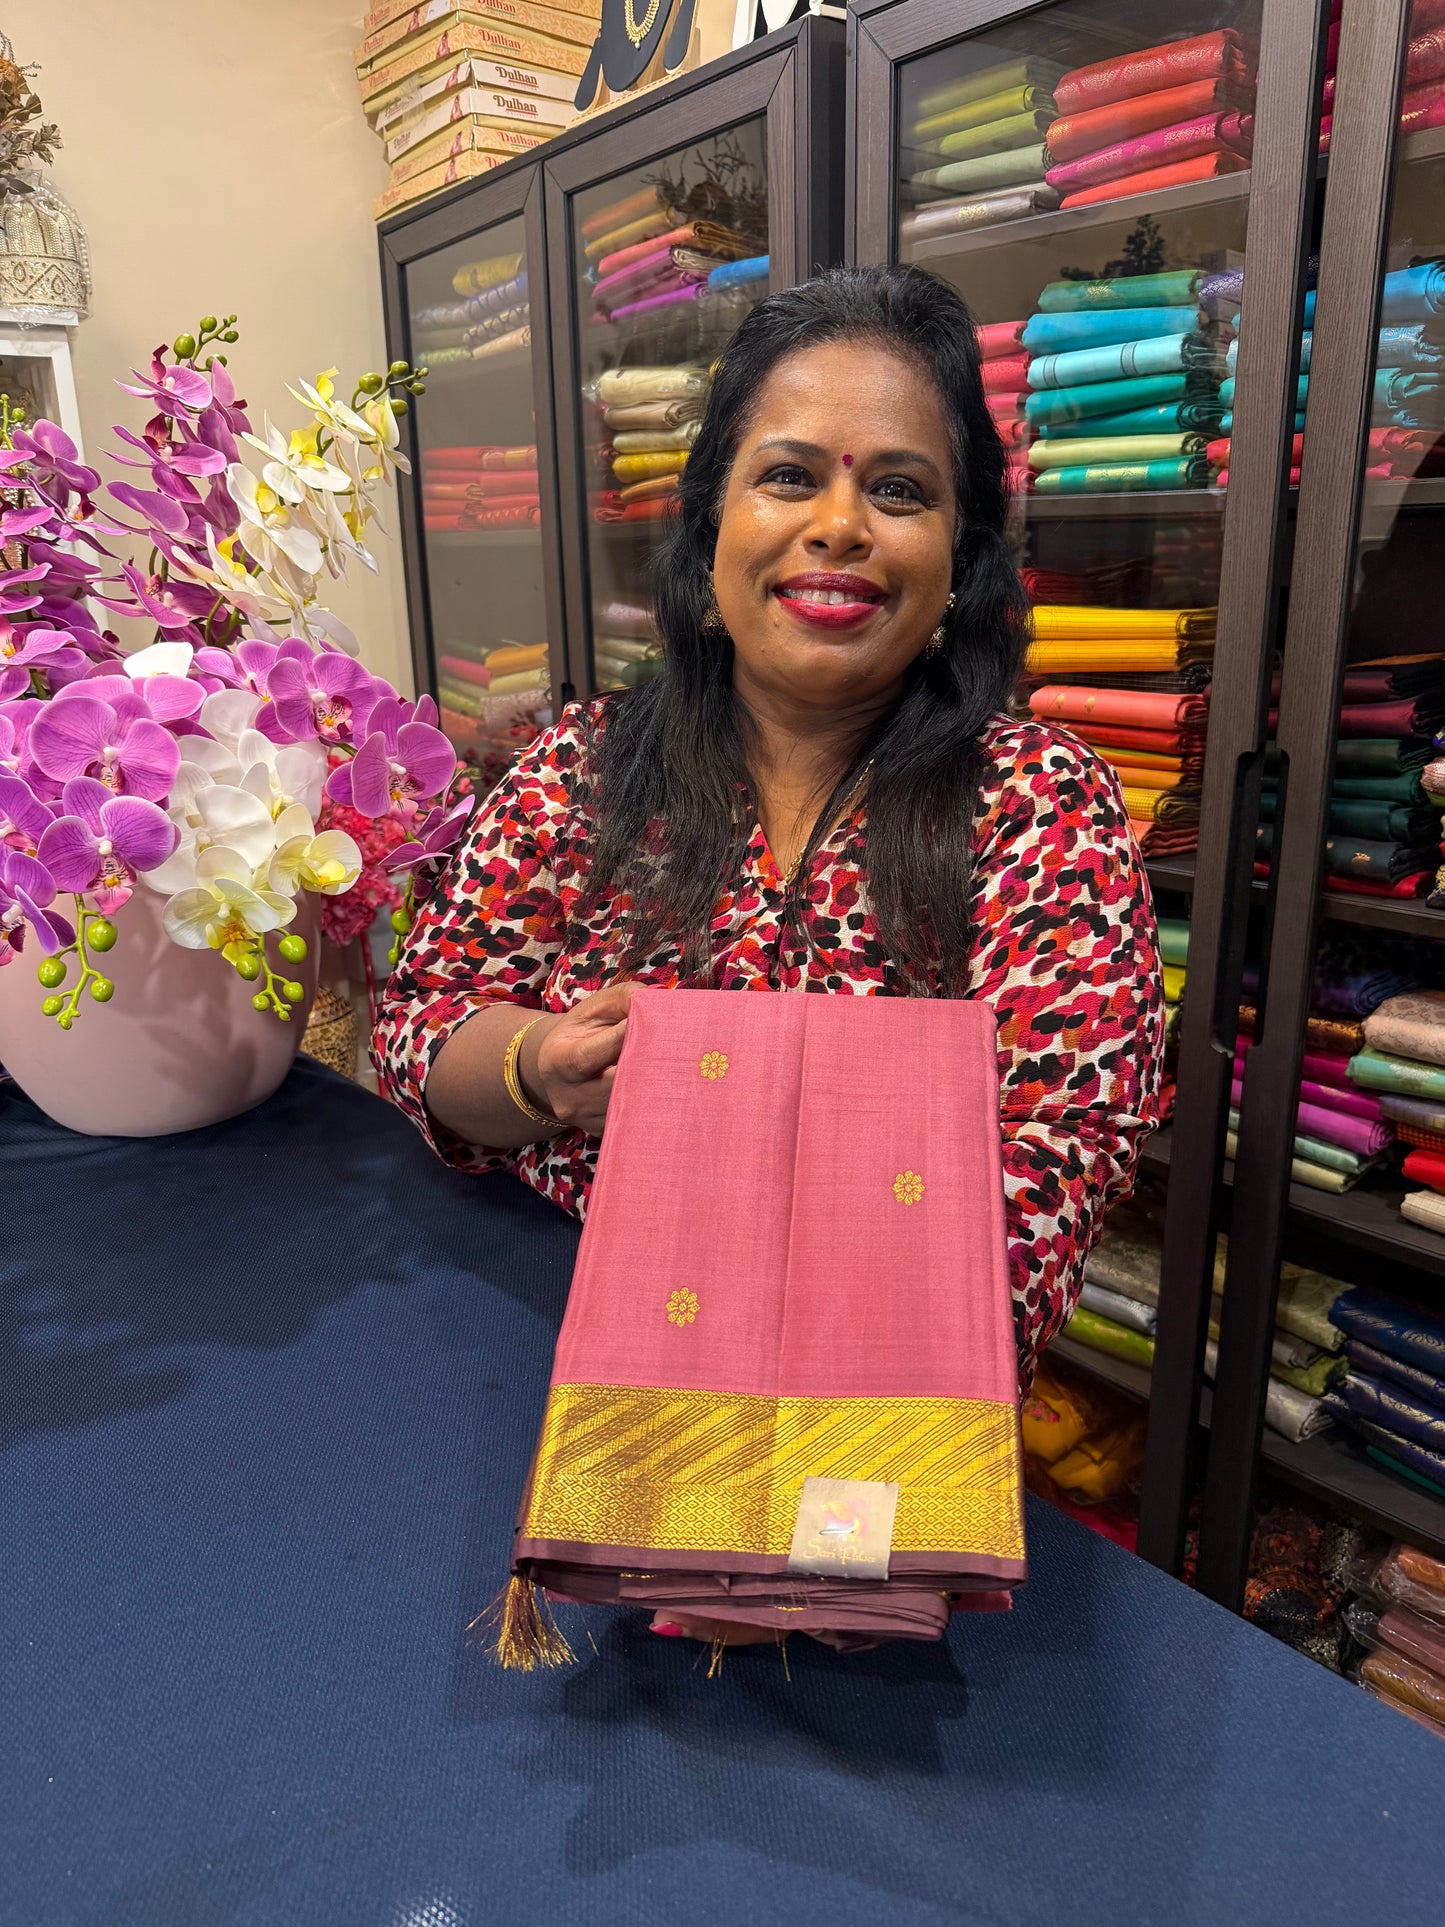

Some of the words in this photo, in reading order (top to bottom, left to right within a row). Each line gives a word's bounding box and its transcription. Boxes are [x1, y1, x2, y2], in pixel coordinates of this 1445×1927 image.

[478, 29, 521, 49] Dulhan
[494, 65, 538, 86] Dulhan
[492, 94, 538, 114] Dulhan
[496, 130, 540, 147] Dulhan
